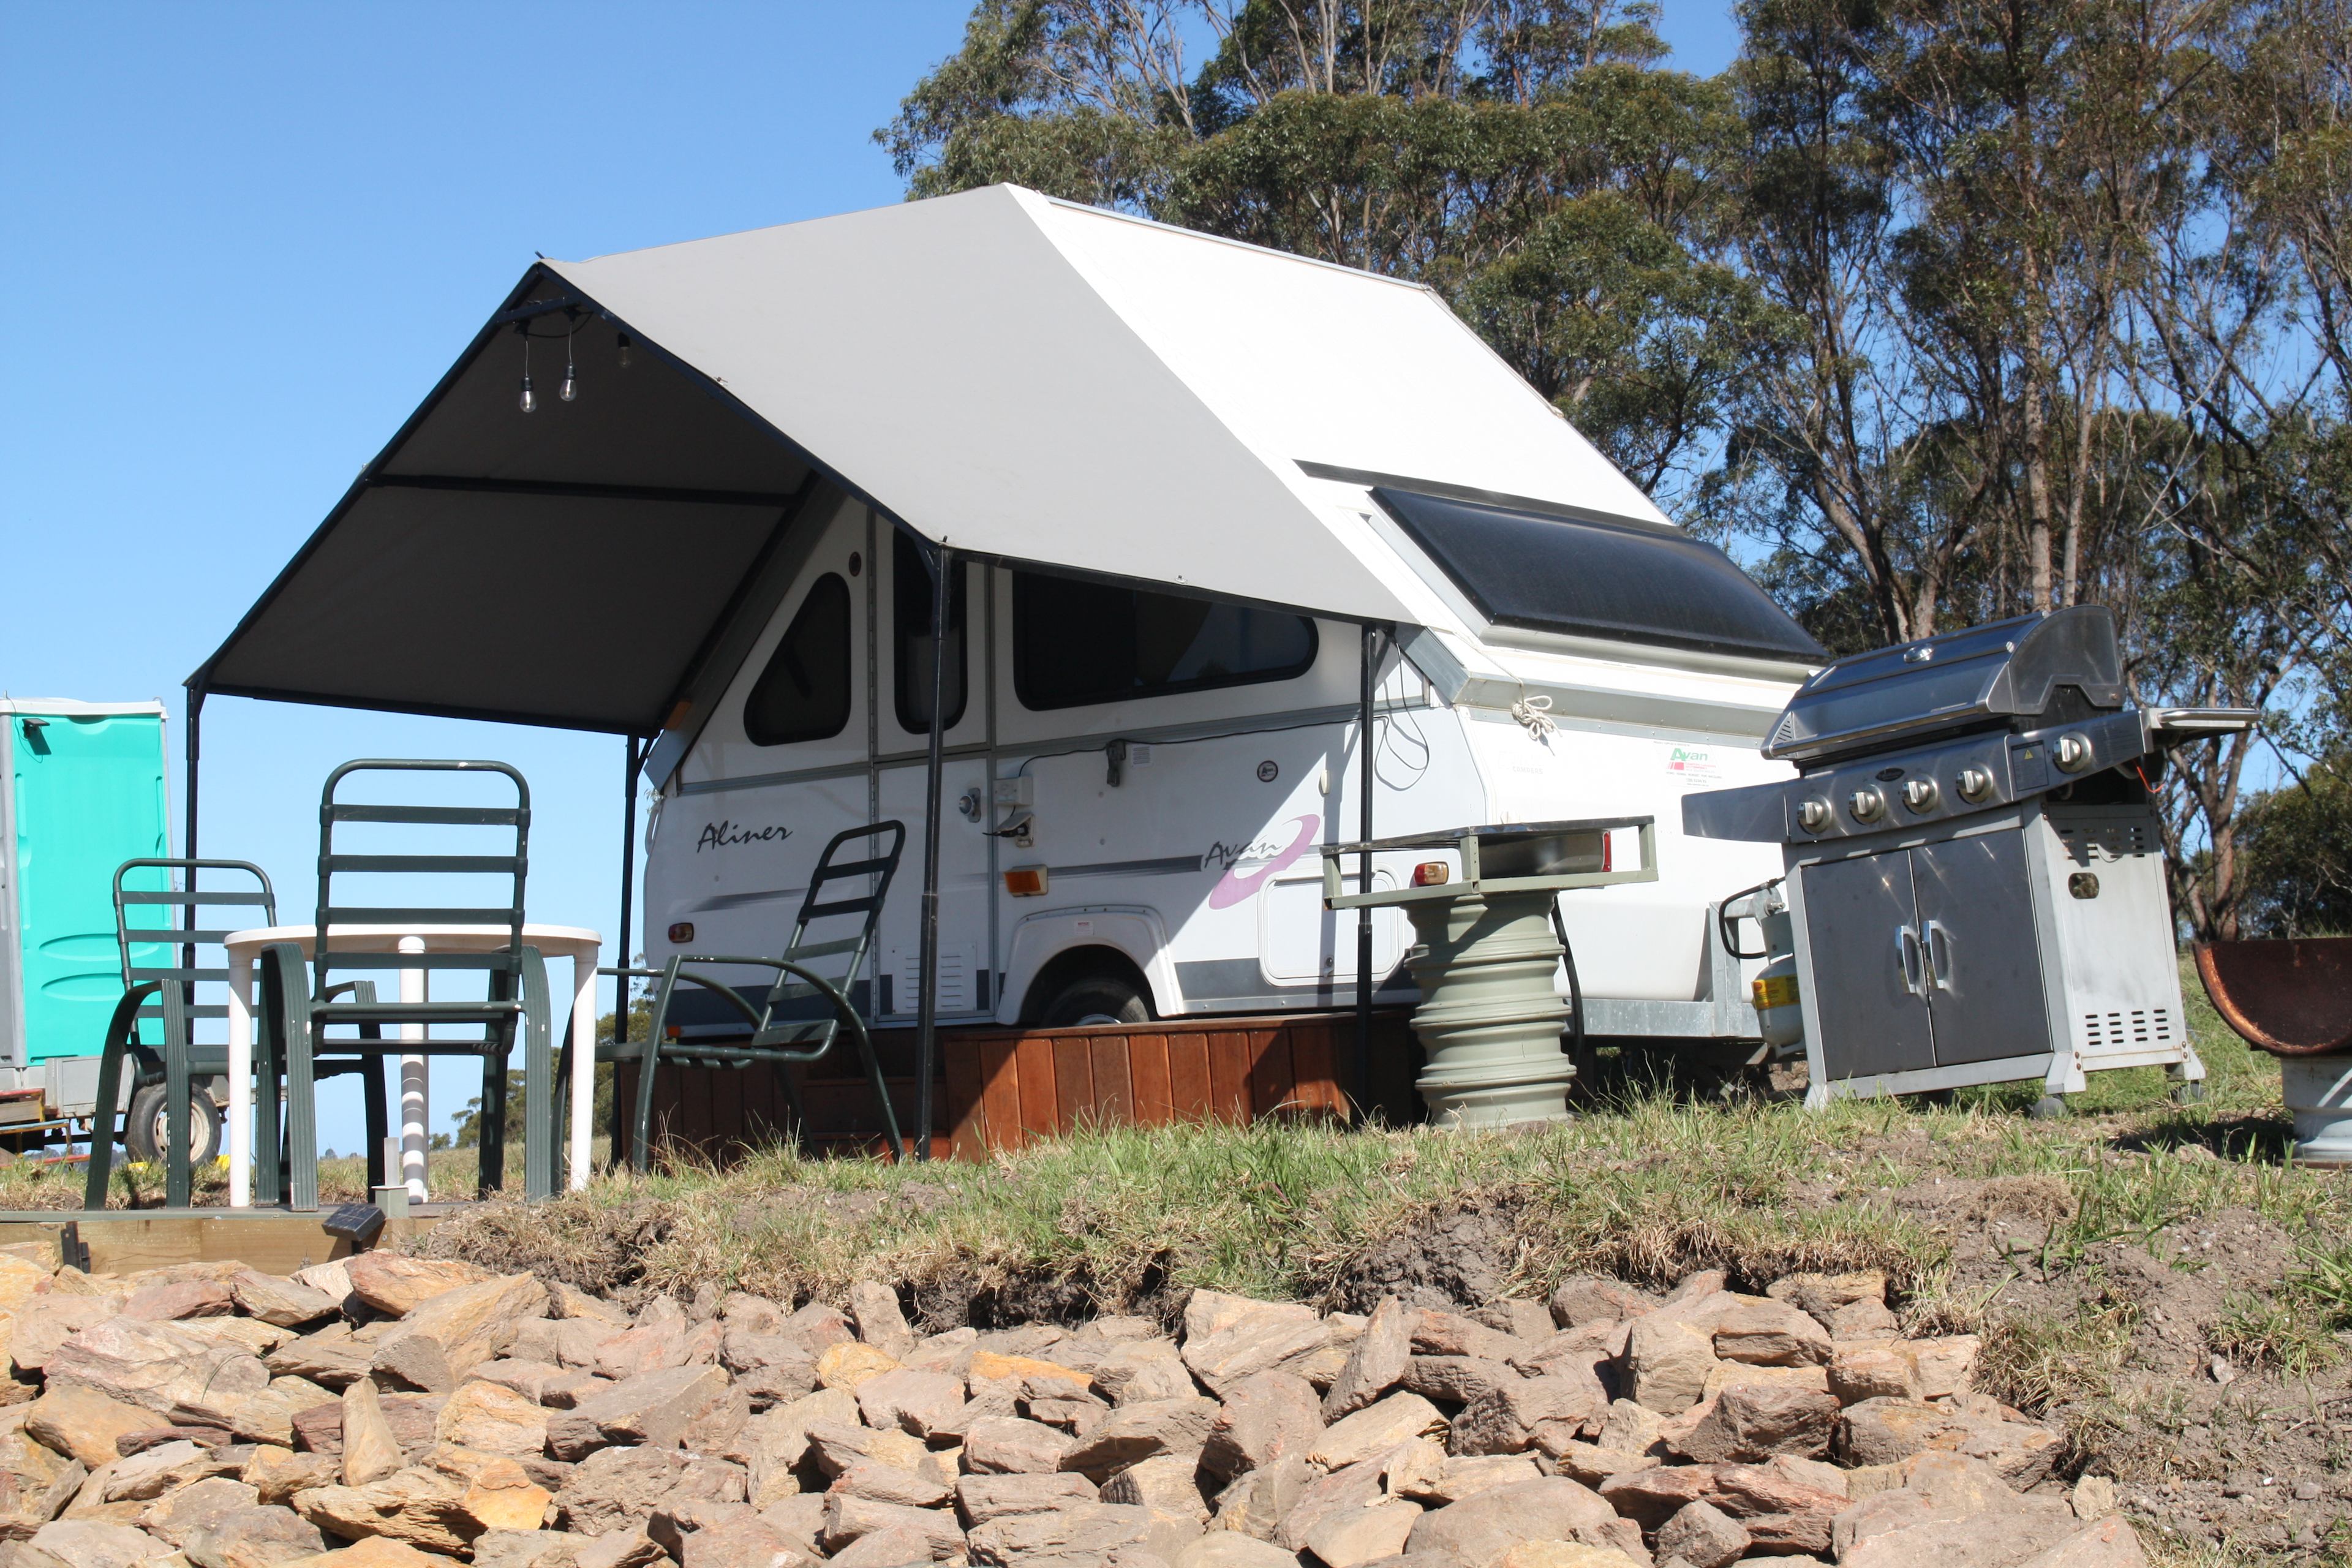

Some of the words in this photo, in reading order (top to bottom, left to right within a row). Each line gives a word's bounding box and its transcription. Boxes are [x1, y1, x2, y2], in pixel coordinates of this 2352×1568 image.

[1670, 748, 1708, 761] Avan
[697, 820, 793, 853] Aliner
[1204, 841, 1283, 869] Avan
